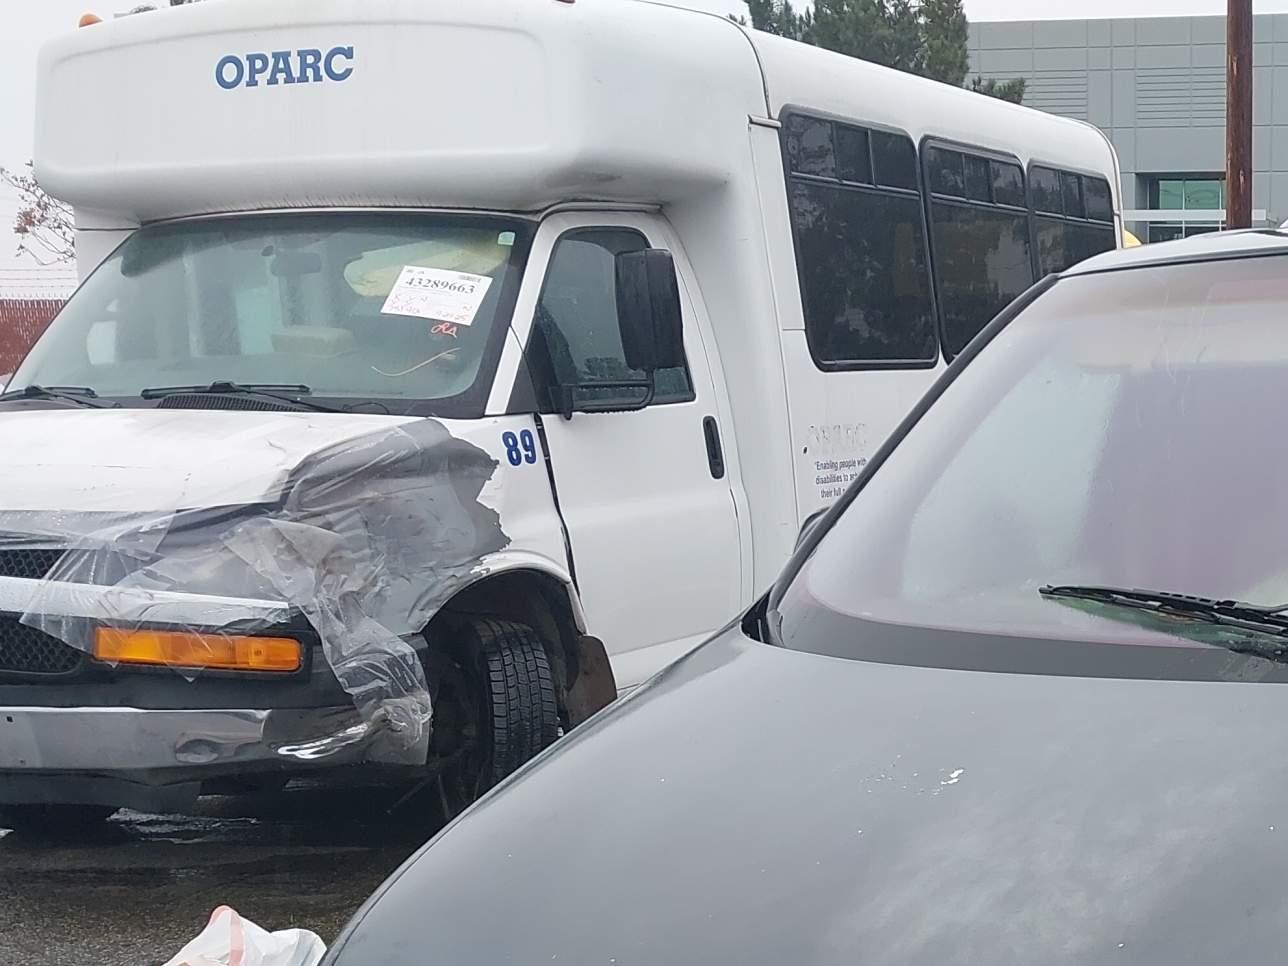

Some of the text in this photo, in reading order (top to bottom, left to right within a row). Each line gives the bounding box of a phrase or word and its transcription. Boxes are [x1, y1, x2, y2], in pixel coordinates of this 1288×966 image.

[215, 46, 354, 89] OPARC
[405, 277, 476, 295] 43289663
[502, 429, 537, 466] 89
